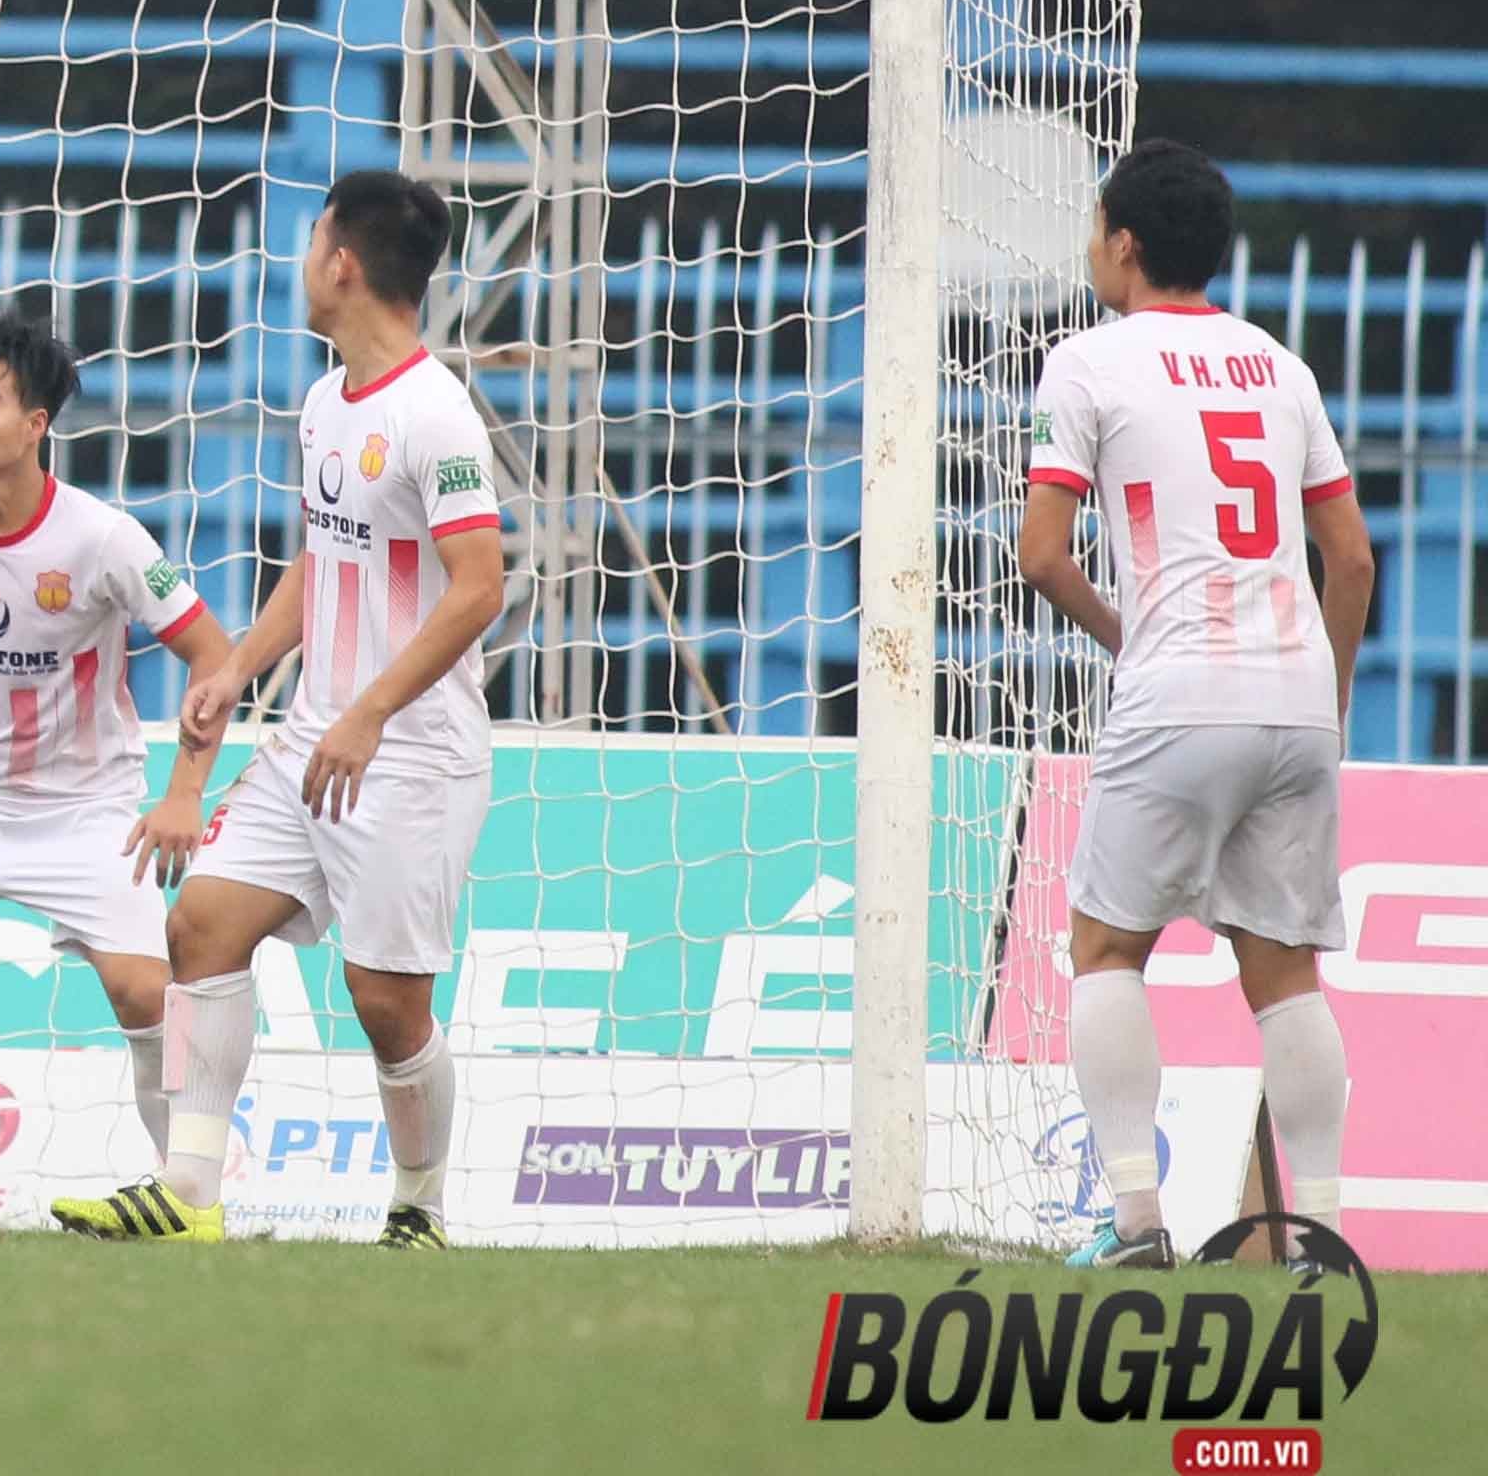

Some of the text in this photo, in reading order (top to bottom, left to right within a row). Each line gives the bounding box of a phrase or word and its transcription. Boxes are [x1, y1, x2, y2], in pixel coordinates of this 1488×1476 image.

[1199, 410, 1279, 559] 5
[266, 1119, 391, 1174] PTI
[623, 1143, 851, 1194] TUYLIP
